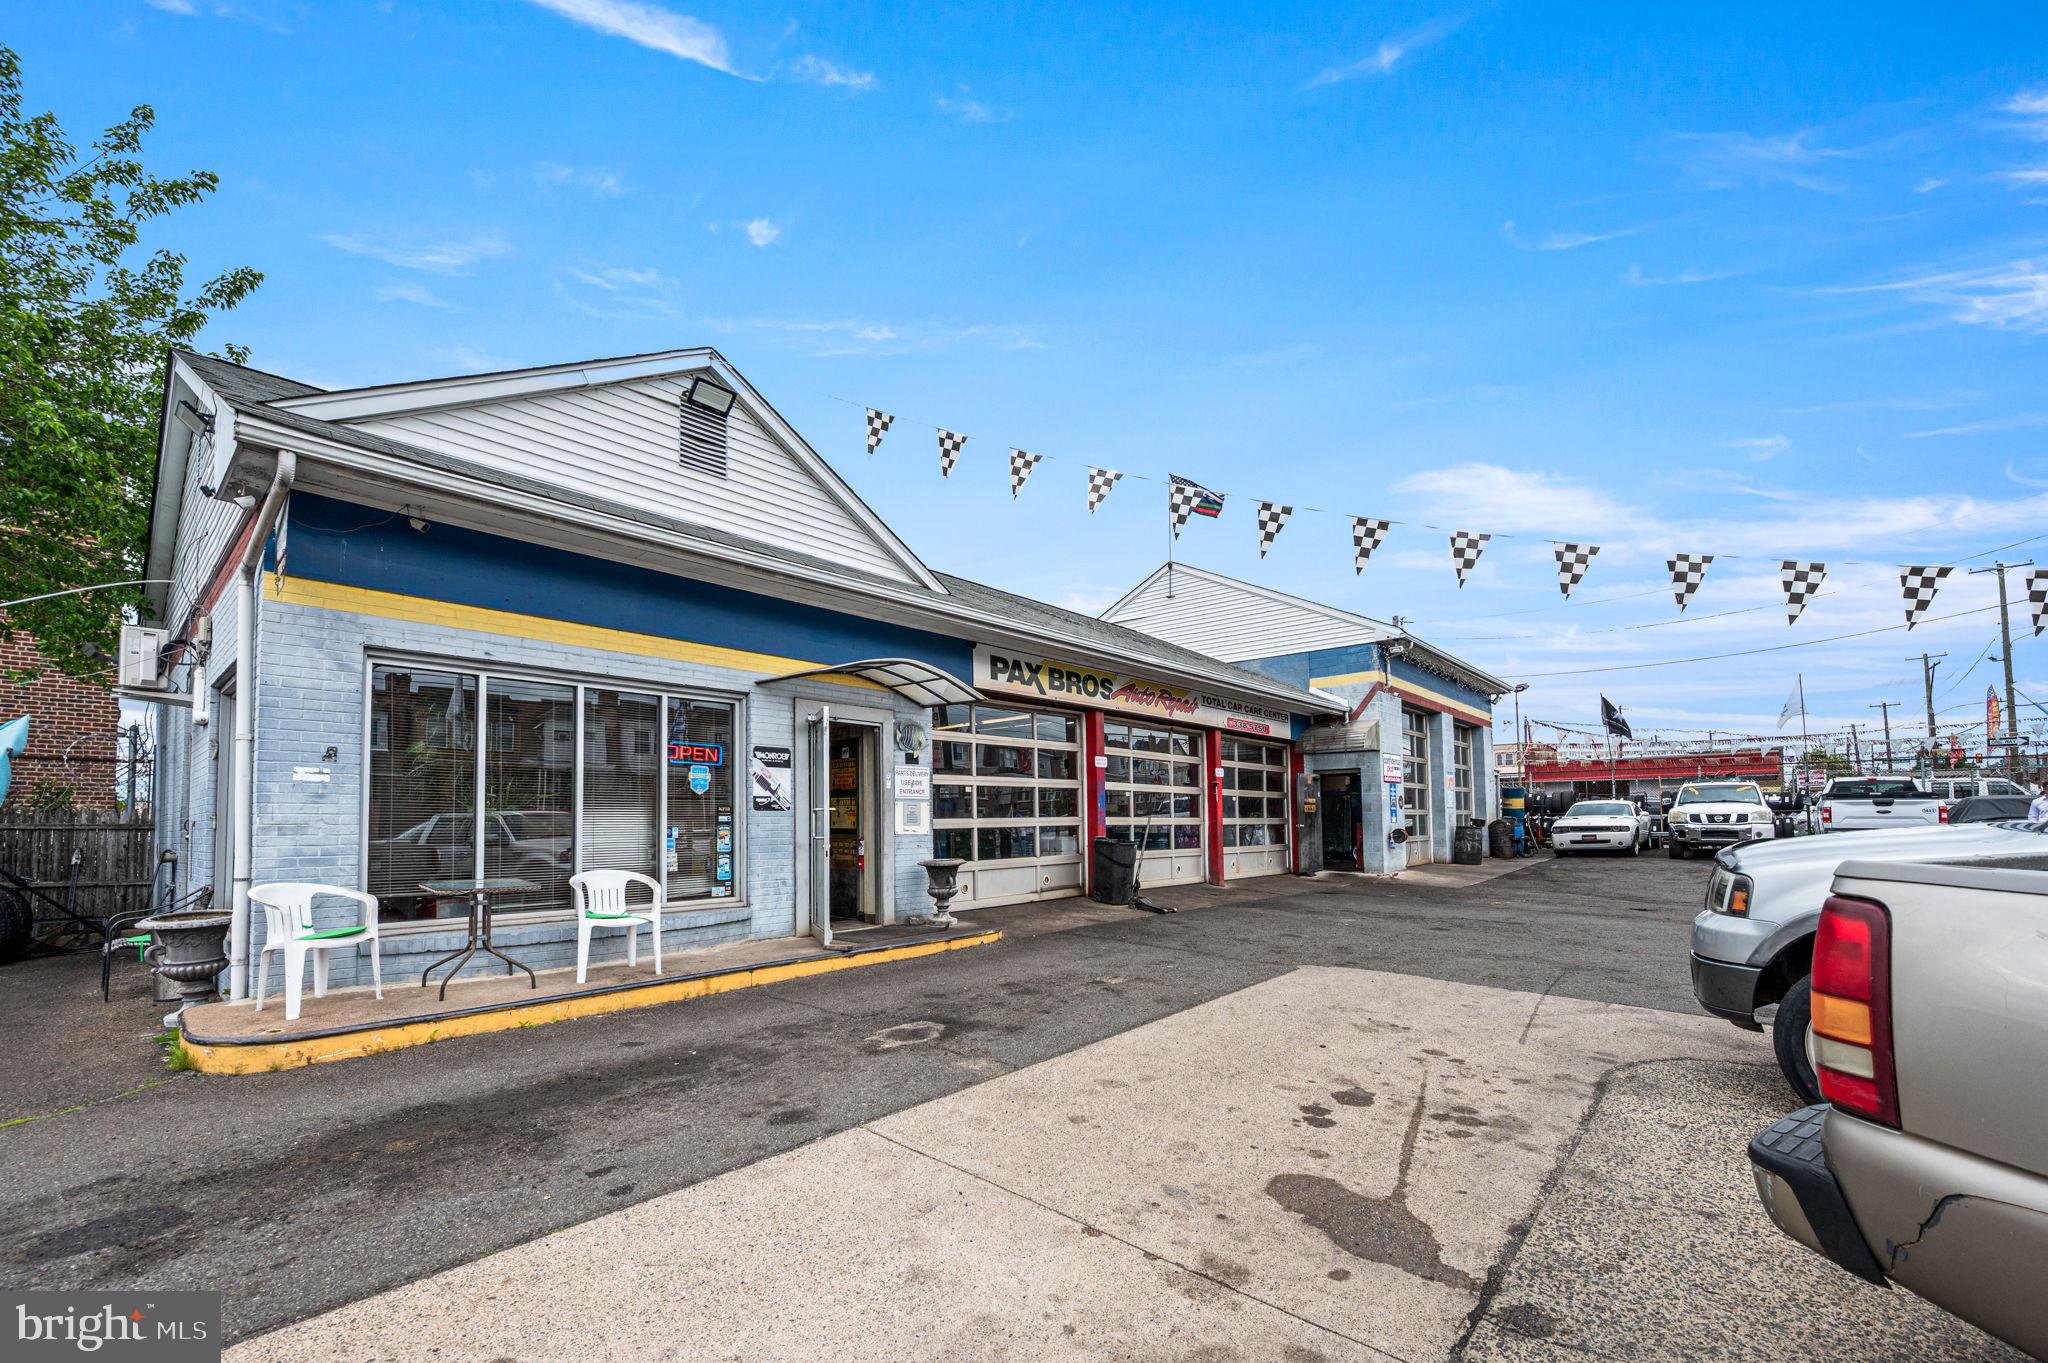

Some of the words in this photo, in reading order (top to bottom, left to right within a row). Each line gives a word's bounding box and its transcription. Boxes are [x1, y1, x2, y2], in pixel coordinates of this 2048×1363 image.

[990, 654, 1047, 696] PAX
[1048, 667, 1114, 700] BROS
[1110, 682, 1157, 708] Auto
[1154, 687, 1201, 718] Repair
[1201, 695, 1226, 709] TOTAL
[1227, 701, 1242, 712] CAR
[1244, 705, 1262, 716] CARE
[1263, 709, 1289, 722] CENTER
[1232, 720, 1247, 729] 338
[1249, 722, 1267, 733] 5750
[667, 744, 719, 762] OPEN
